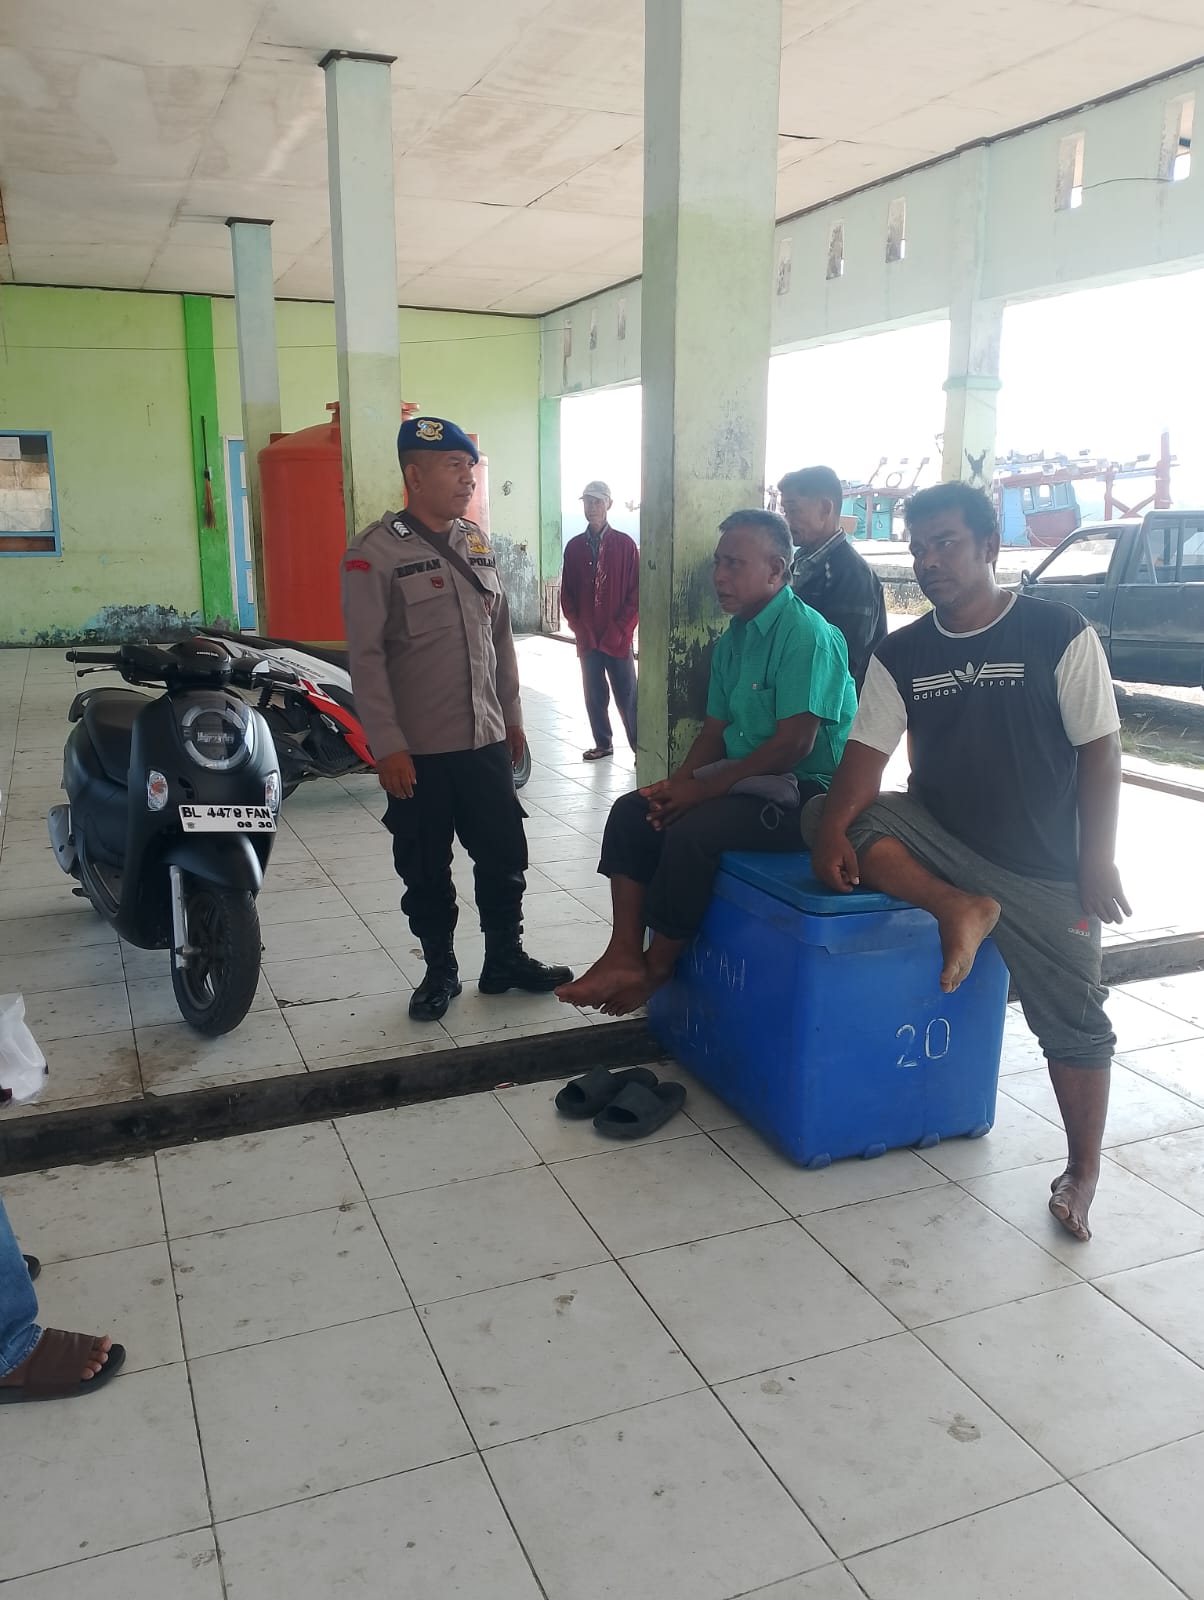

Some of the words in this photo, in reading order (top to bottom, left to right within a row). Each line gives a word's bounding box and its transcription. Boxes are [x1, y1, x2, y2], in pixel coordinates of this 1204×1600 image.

[913, 688, 957, 700] adidas
[182, 807, 202, 818] BL
[245, 808, 271, 819] FAN
[896, 1018, 950, 1068] 20
